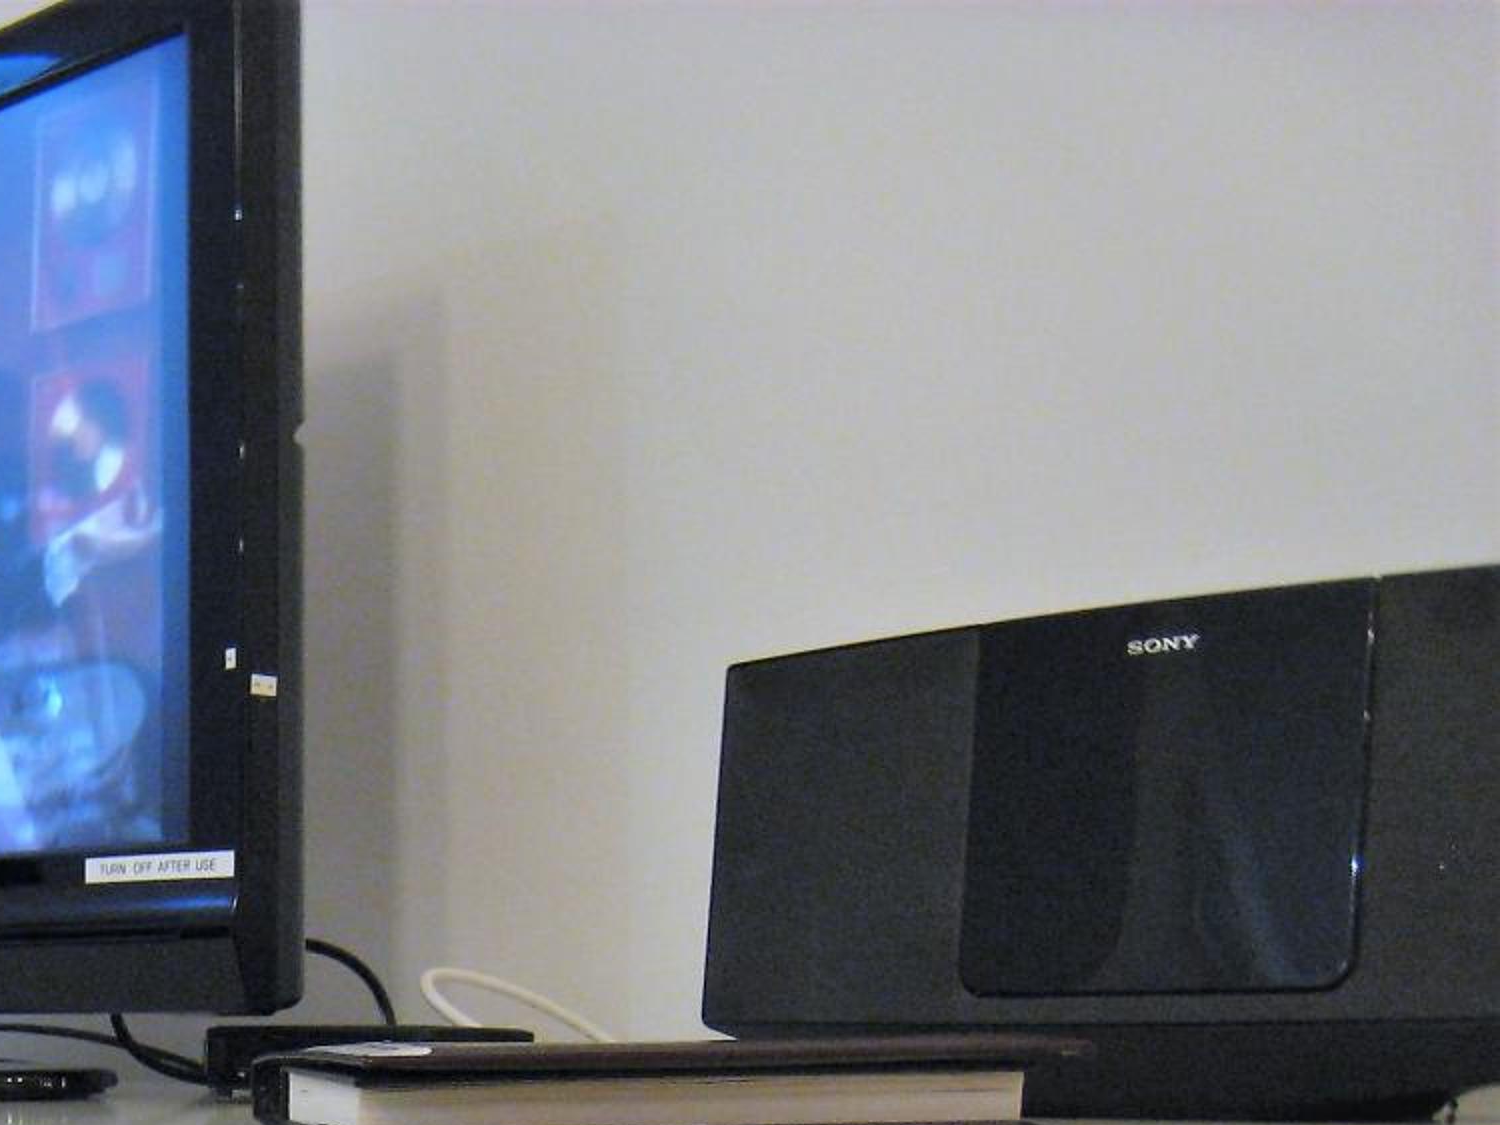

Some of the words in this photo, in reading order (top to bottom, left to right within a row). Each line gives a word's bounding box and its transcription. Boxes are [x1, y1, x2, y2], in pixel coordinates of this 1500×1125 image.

[1127, 634, 1200, 655] SONY
[100, 863, 127, 875] TURN
[133, 861, 152, 873] OFF
[158, 860, 190, 872] AFTER
[195, 858, 215, 871] USE
